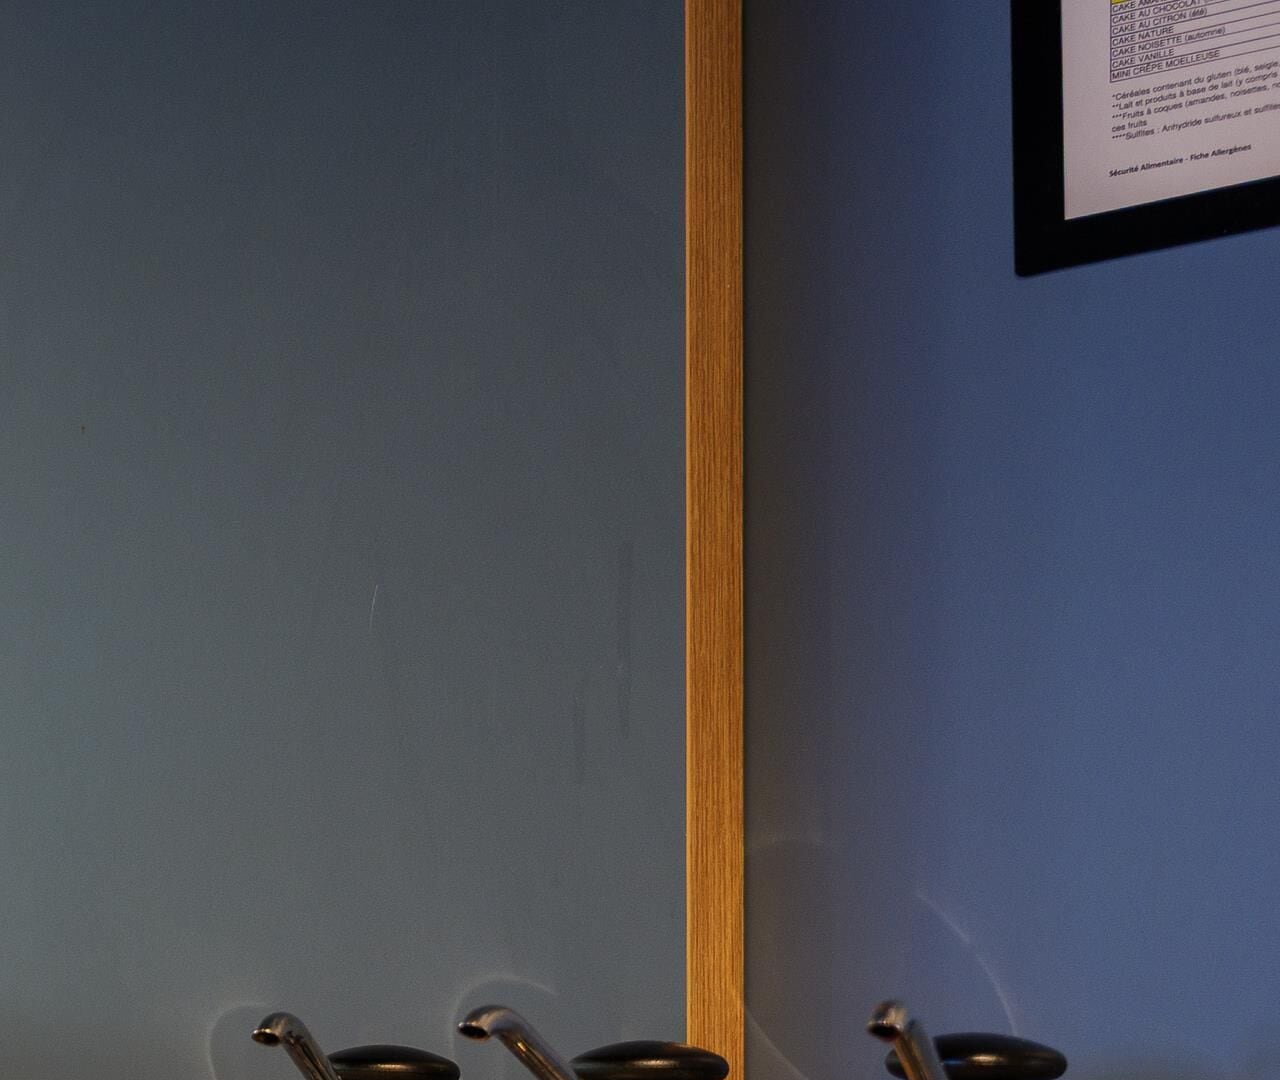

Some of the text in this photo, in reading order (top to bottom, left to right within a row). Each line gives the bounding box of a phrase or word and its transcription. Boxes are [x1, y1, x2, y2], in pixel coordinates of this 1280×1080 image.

[1112, 1, 1136, 13] CAKE
[1112, 13, 1136, 24] CAKE
[1138, 8, 1150, 18] AU
[1112, 24, 1136, 35] CAKE
[1138, 19, 1150, 29] AU
[1153, 12, 1186, 26] CITRON
[1112, 26, 1174, 46] CAKE NATURE
[1112, 26, 1226, 57] CAKE NOISETTE (automne)
[1112, 48, 1174, 68] CAKE VANILLE
[1112, 49, 1220, 79] MINI CRÊPE MOELLEUSE
[1135, 98, 1143, 107] et
[1145, 92, 1177, 106] produits
[1186, 86, 1206, 96] base
[1208, 83, 1219, 92] de
[1221, 79, 1233, 89] lait
[1245, 71, 1278, 84] compris
[1152, 78, 1192, 92] contenant
[1194, 75, 1205, 85] du
[1207, 70, 1232, 84] gluten
[1153, 102, 1183, 114] coques
[1128, 119, 1148, 129] fruits
[1161, 118, 1202, 133] Anhydride
[1109, 163, 1139, 177] Sécurité
[1141, 156, 1183, 171] Alimentaire
[1190, 150, 1210, 161] Fiche
[1211, 143, 1252, 156] Allergènes
